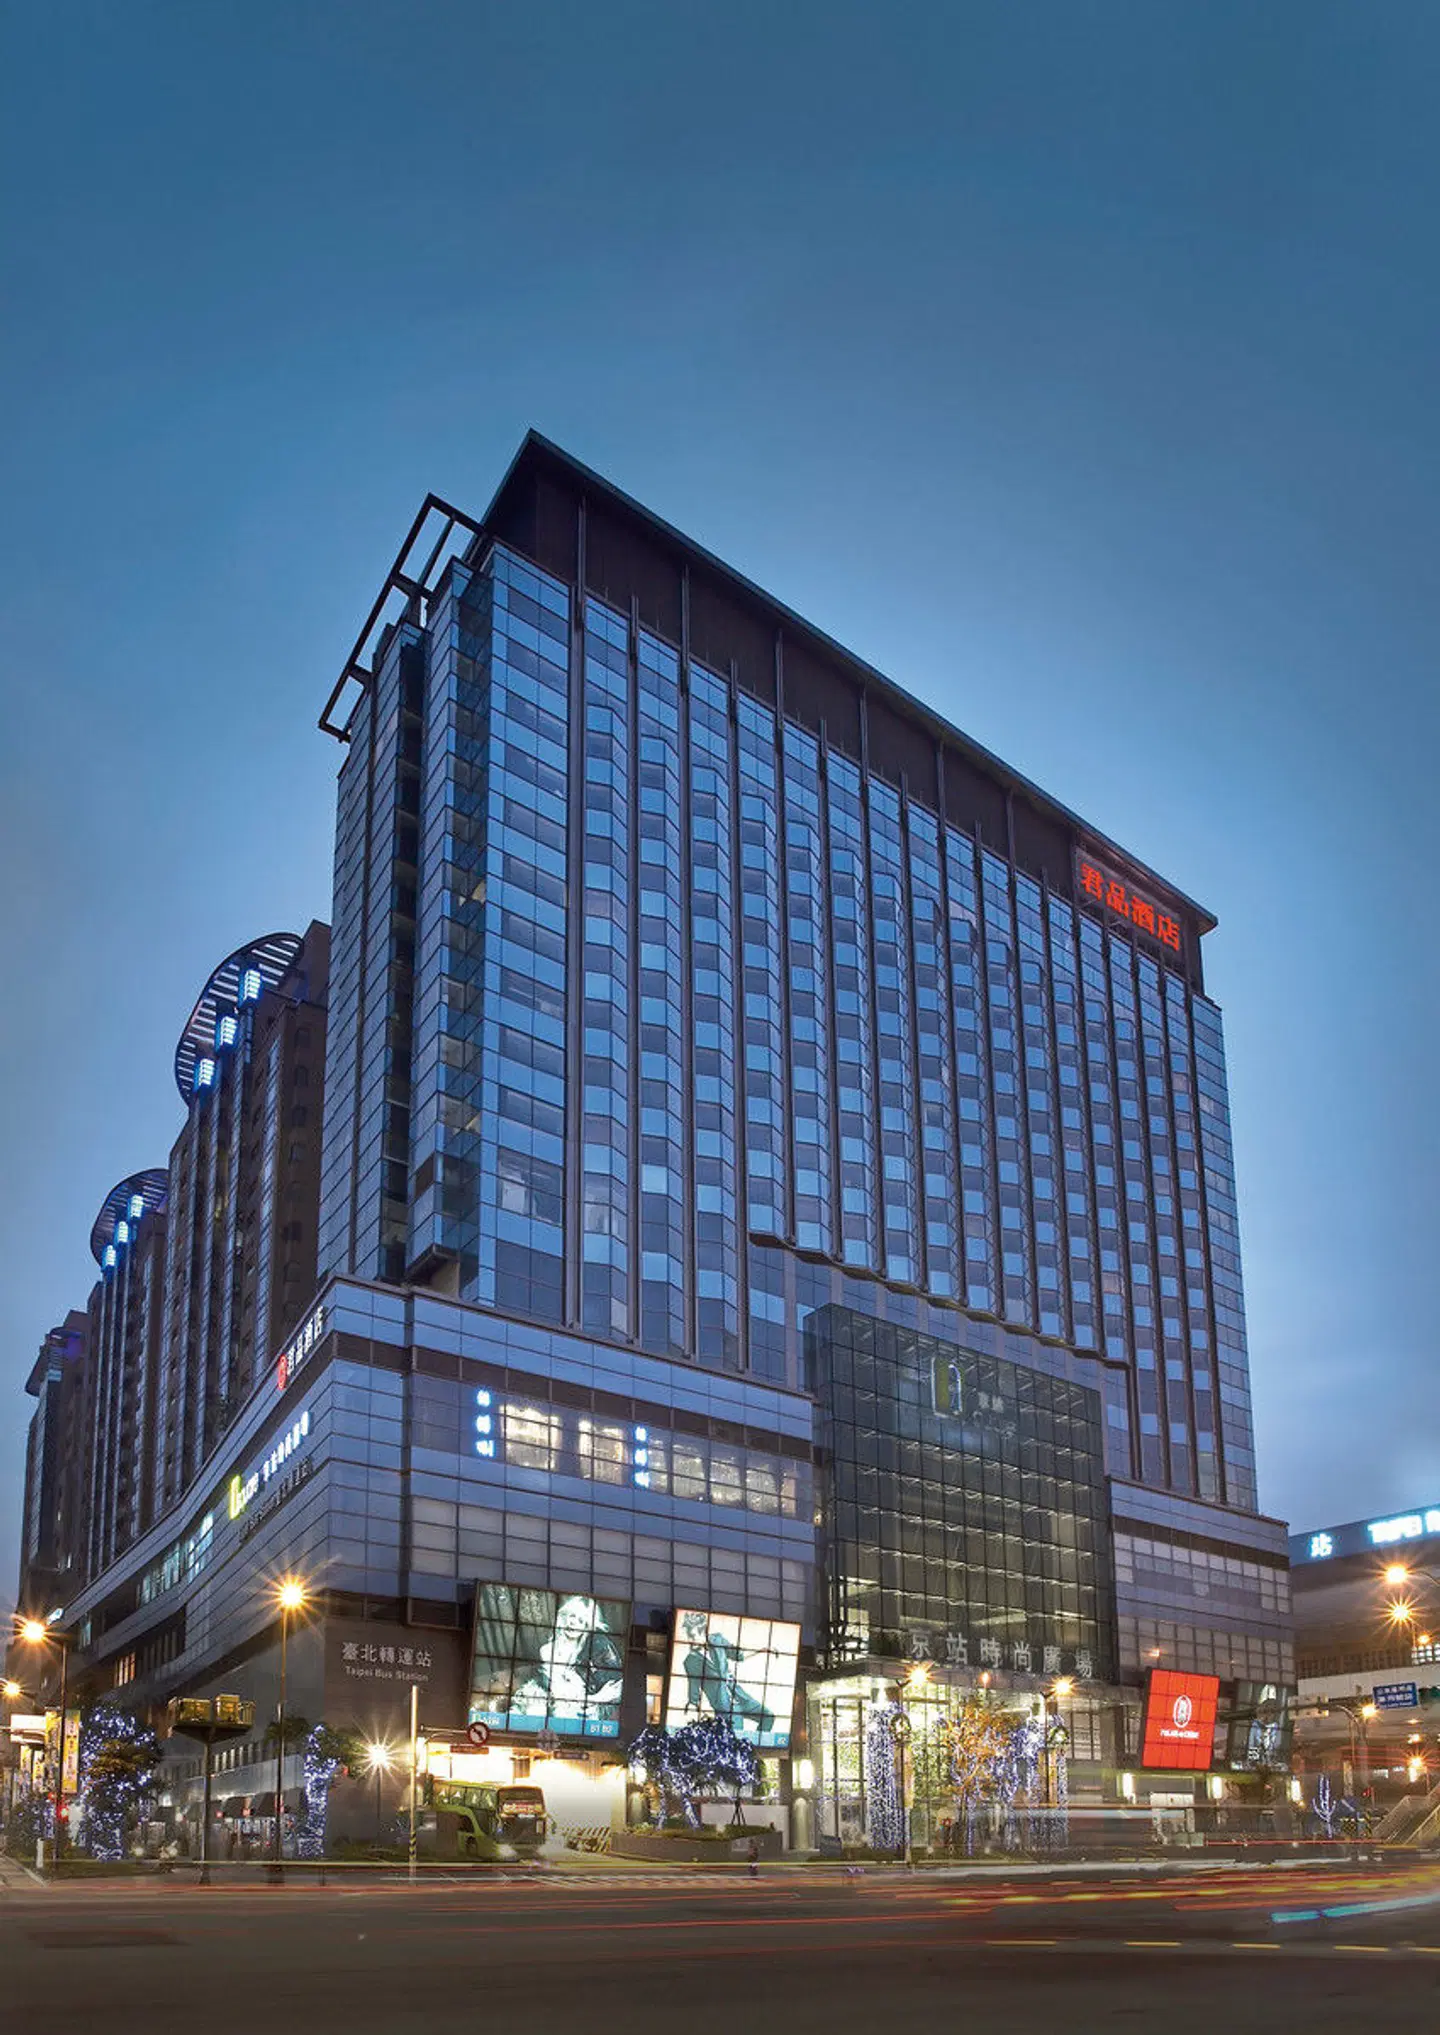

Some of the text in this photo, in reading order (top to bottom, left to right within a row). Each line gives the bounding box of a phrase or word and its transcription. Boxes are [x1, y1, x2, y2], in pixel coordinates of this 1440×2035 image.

[1080, 863, 1181, 951] 君品酒店
[1311, 1533, 1332, 1558] 站
[342, 1642, 432, 1667] 臺北轉運站
[909, 1627, 1095, 1679] 京站時尚廣場
[345, 1667, 429, 1682] Taipei Bus Station
